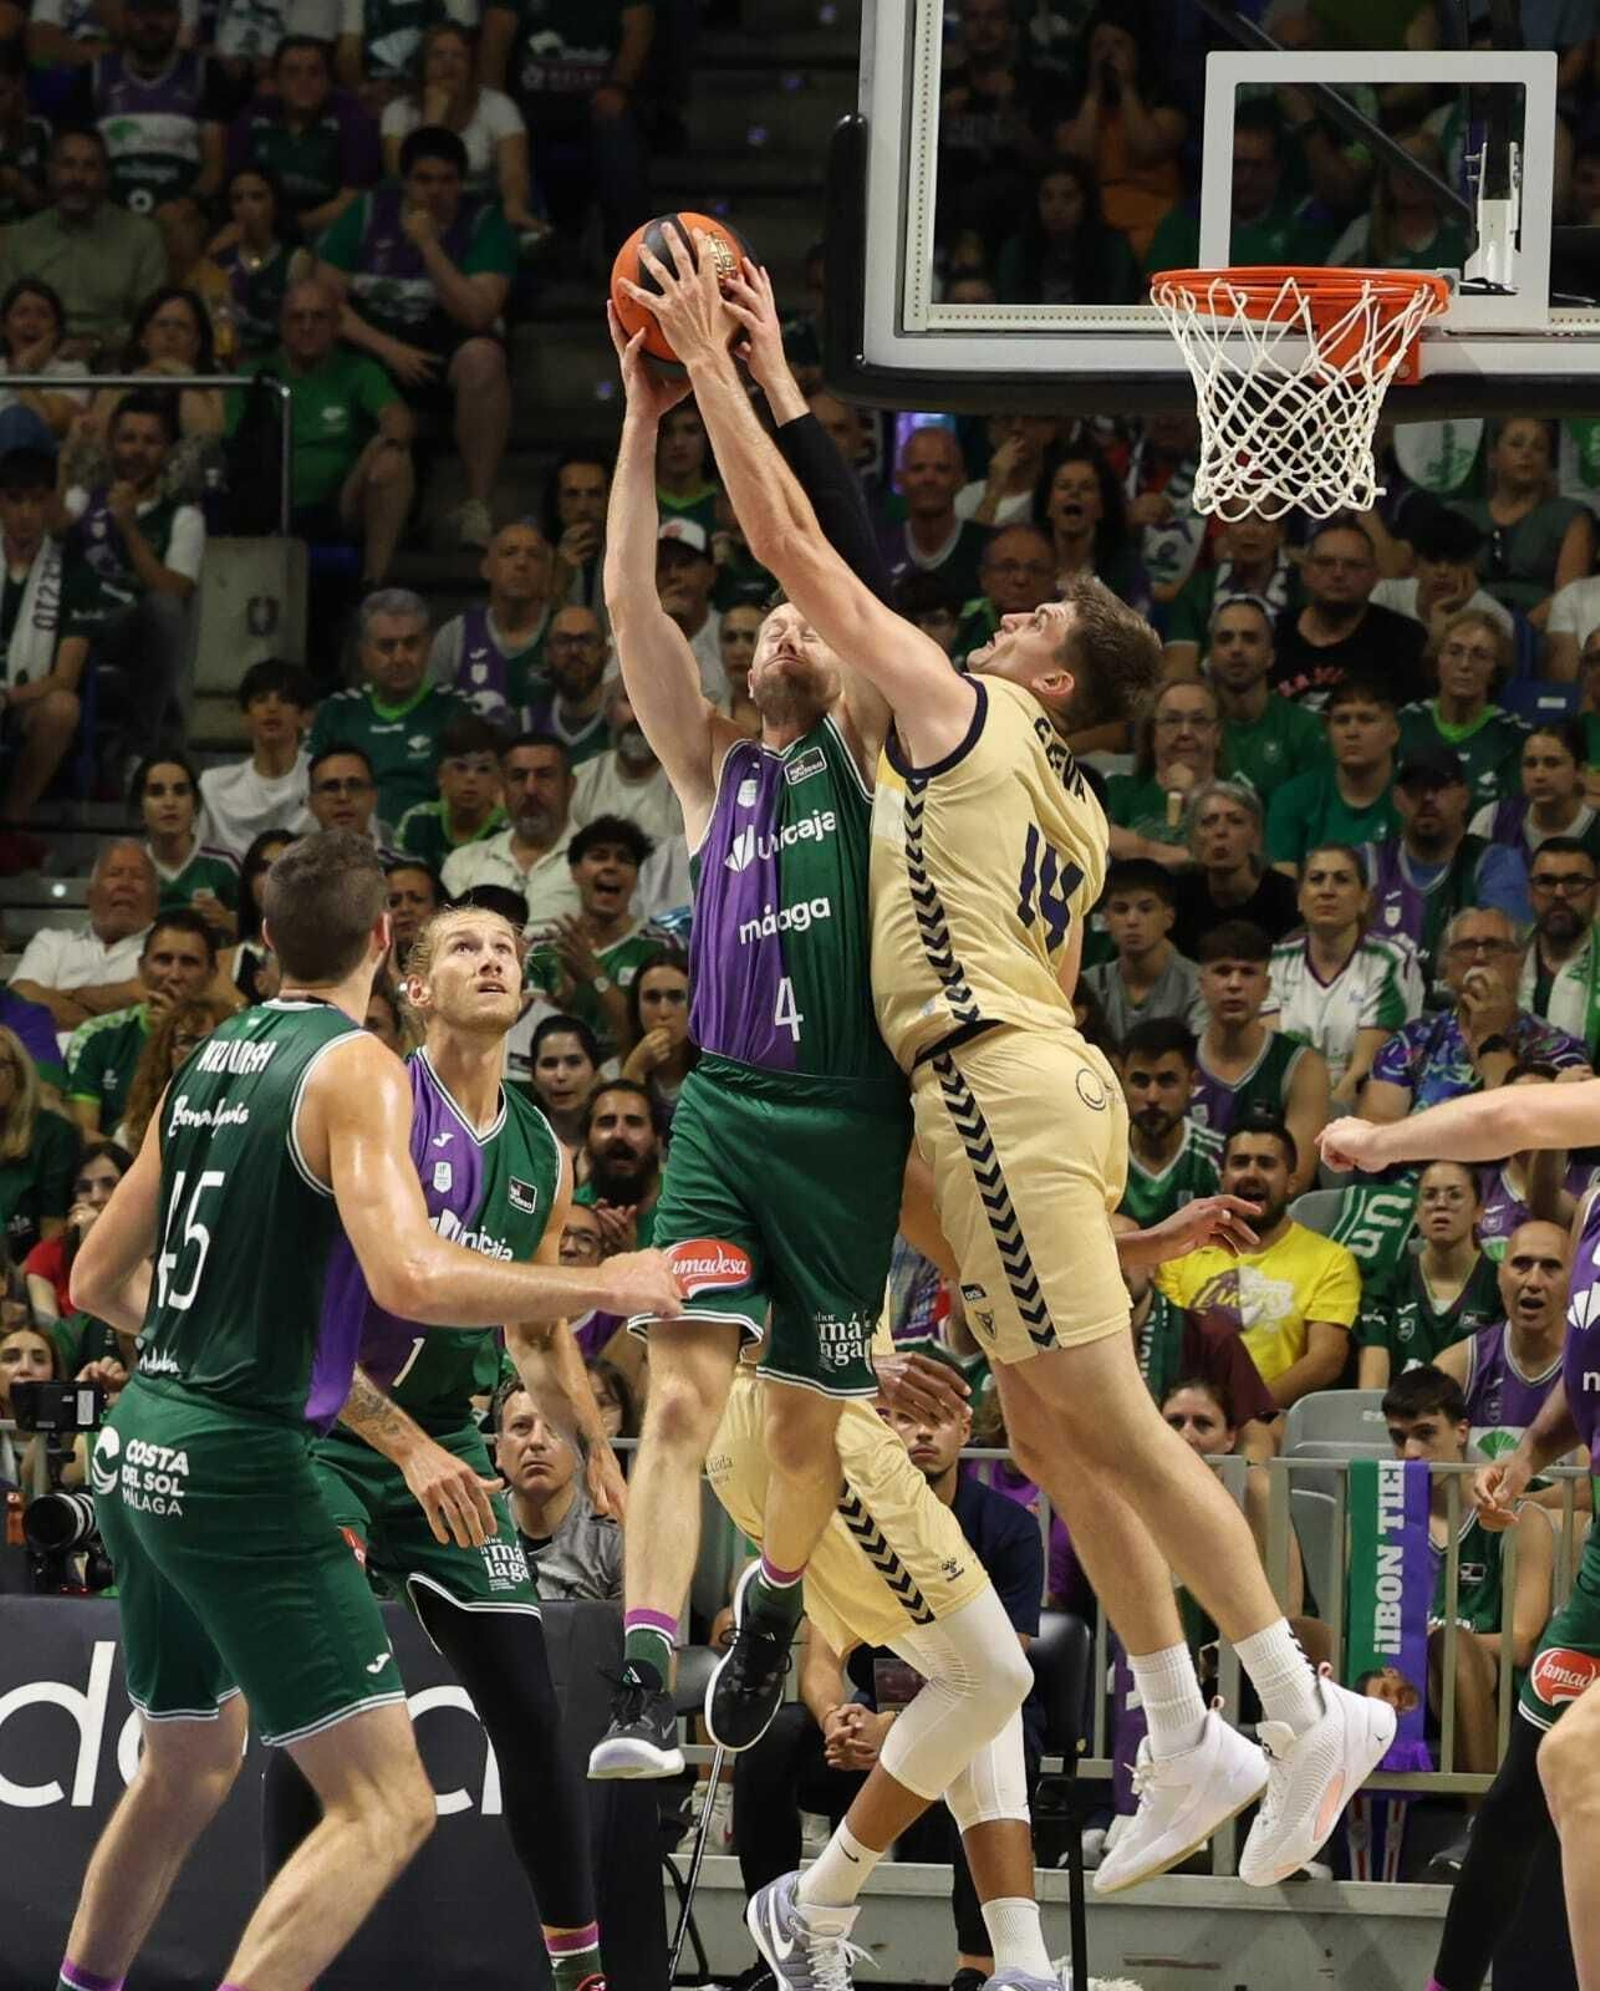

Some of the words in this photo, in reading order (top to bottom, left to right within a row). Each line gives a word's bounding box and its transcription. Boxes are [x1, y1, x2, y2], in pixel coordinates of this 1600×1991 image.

[1017, 821, 1085, 953] 14
[774, 975, 805, 1043] 4
[157, 1170, 226, 1312] 45
[121, 1463, 141, 1488] DEL
[143, 1471, 186, 1498] SOL
[125, 1438, 190, 1476] COSTA
